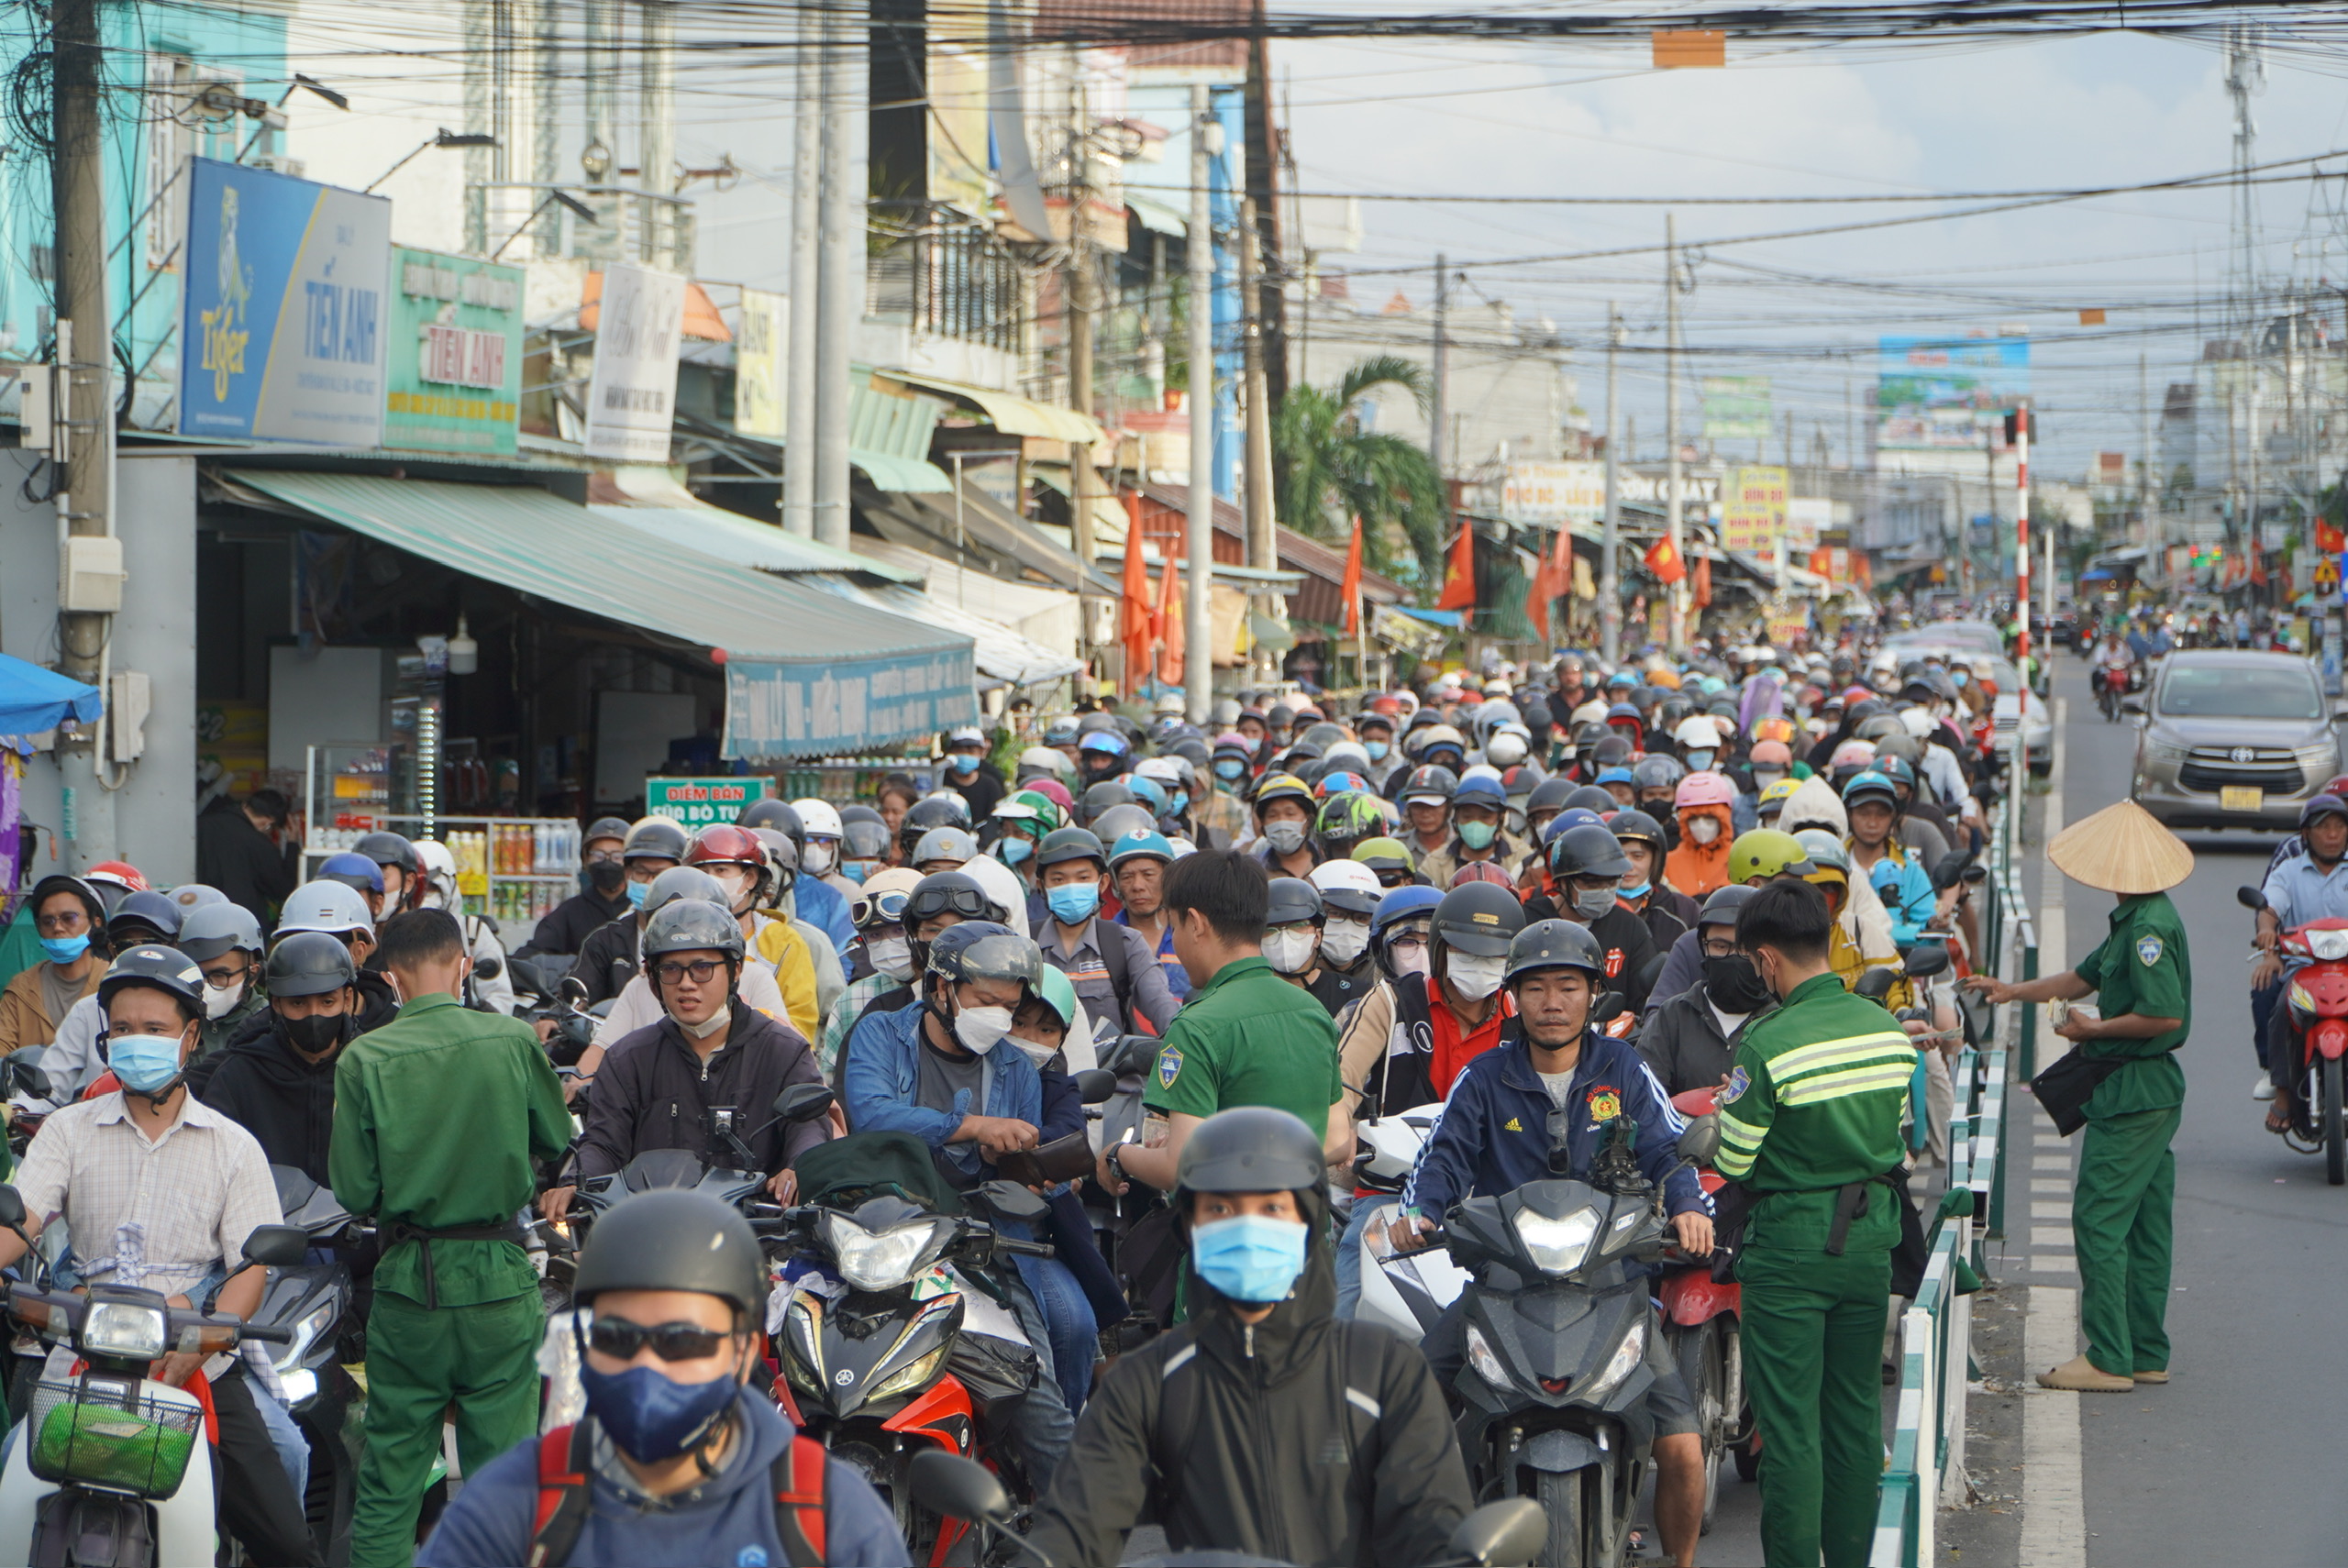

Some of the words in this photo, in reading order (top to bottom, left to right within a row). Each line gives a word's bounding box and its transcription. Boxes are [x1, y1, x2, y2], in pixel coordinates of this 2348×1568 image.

[200, 304, 249, 403] Tiger
[666, 781, 708, 801] ĐIỂM
[711, 784, 745, 801] BÁN
[688, 803, 714, 821] BÒ
